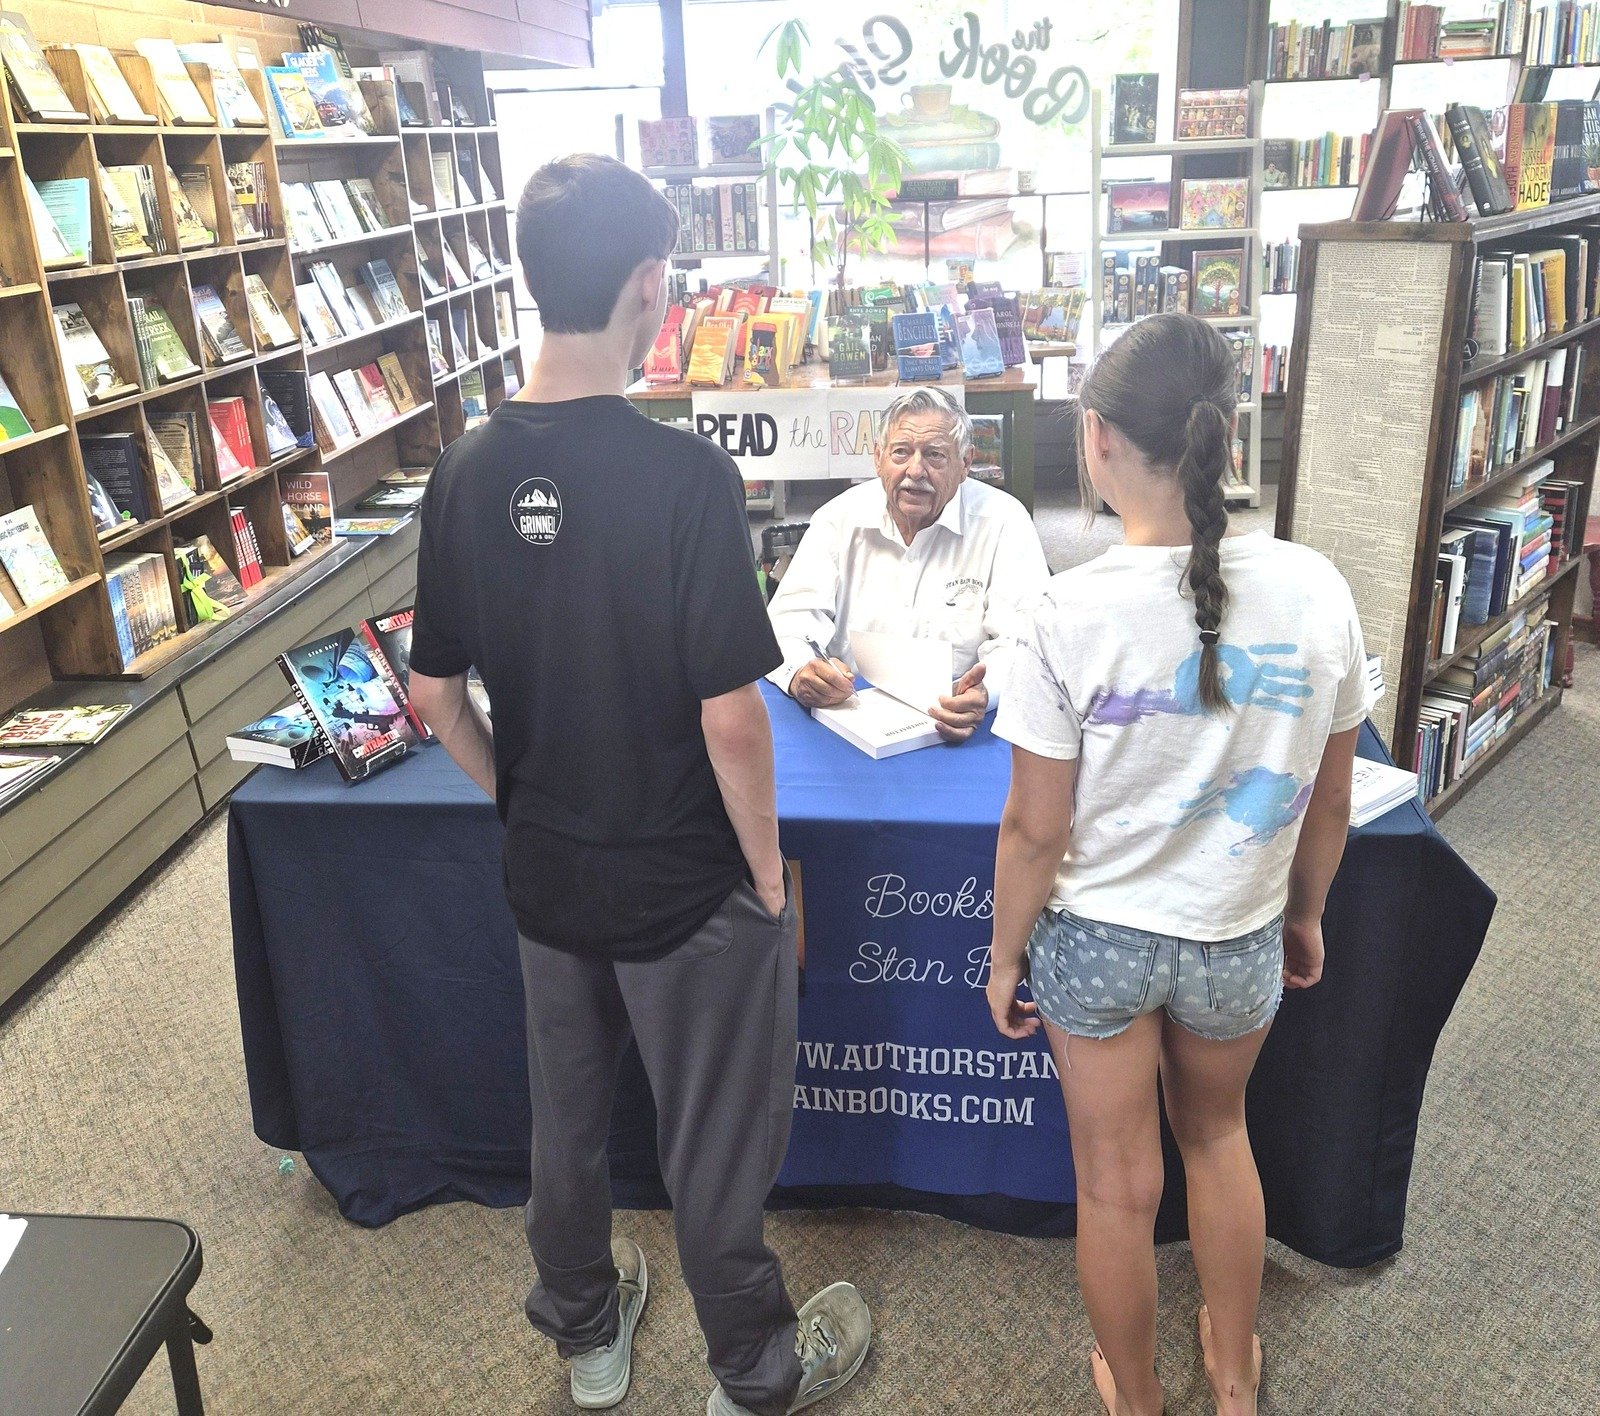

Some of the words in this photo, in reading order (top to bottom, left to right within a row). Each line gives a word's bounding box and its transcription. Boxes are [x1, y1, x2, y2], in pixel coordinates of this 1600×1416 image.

[898, 322, 936, 340] BENCHLEY
[834, 352, 866, 362] BOWEN
[839, 342, 860, 352] GAIL
[696, 412, 778, 456] READ
[789, 416, 827, 448] the
[286, 480, 312, 490] WILD
[287, 491, 322, 501] HORSE
[308, 648, 322, 658] STAN
[374, 648, 408, 706] CONTRACTOR
[22, 713, 64, 740] FEATS
[291, 683, 334, 754] CONTRACTOR
[352, 730, 400, 759] CONTRACTOR
[864, 873, 994, 919] Books
[849, 942, 953, 984] Stan
